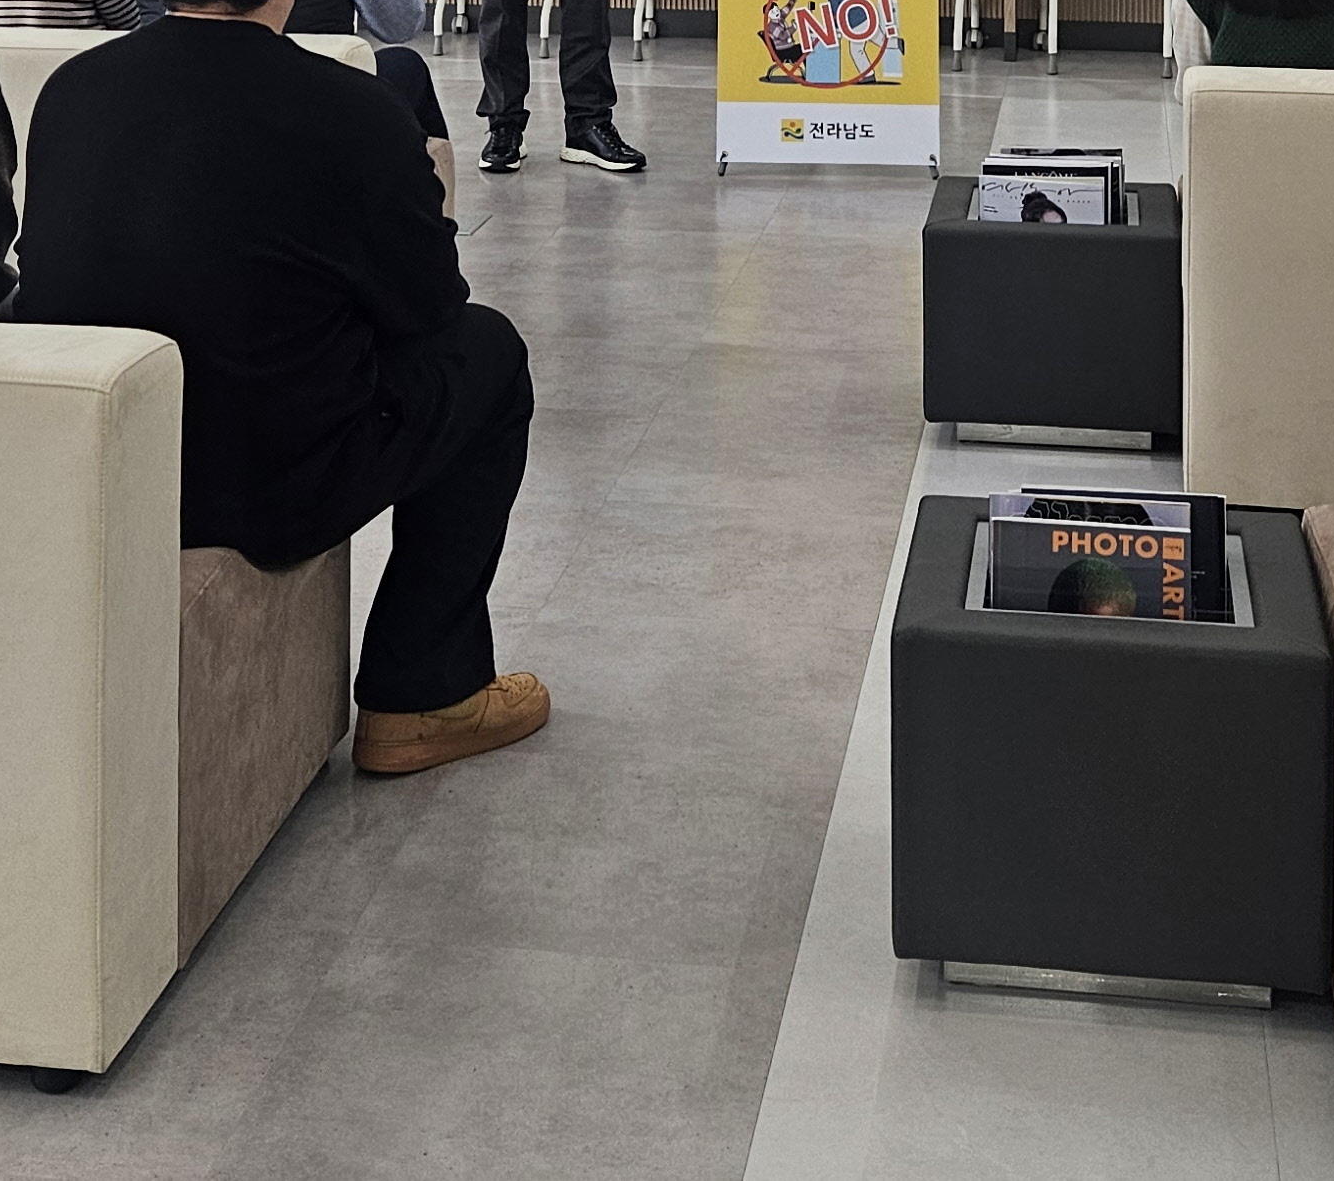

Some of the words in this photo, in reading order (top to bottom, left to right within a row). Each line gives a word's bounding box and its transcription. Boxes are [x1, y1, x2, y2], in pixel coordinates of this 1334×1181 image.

[809, 122, 876, 140] 전라남도
[1051, 530, 1159, 559] PHOTO
[1162, 562, 1185, 621] ART
